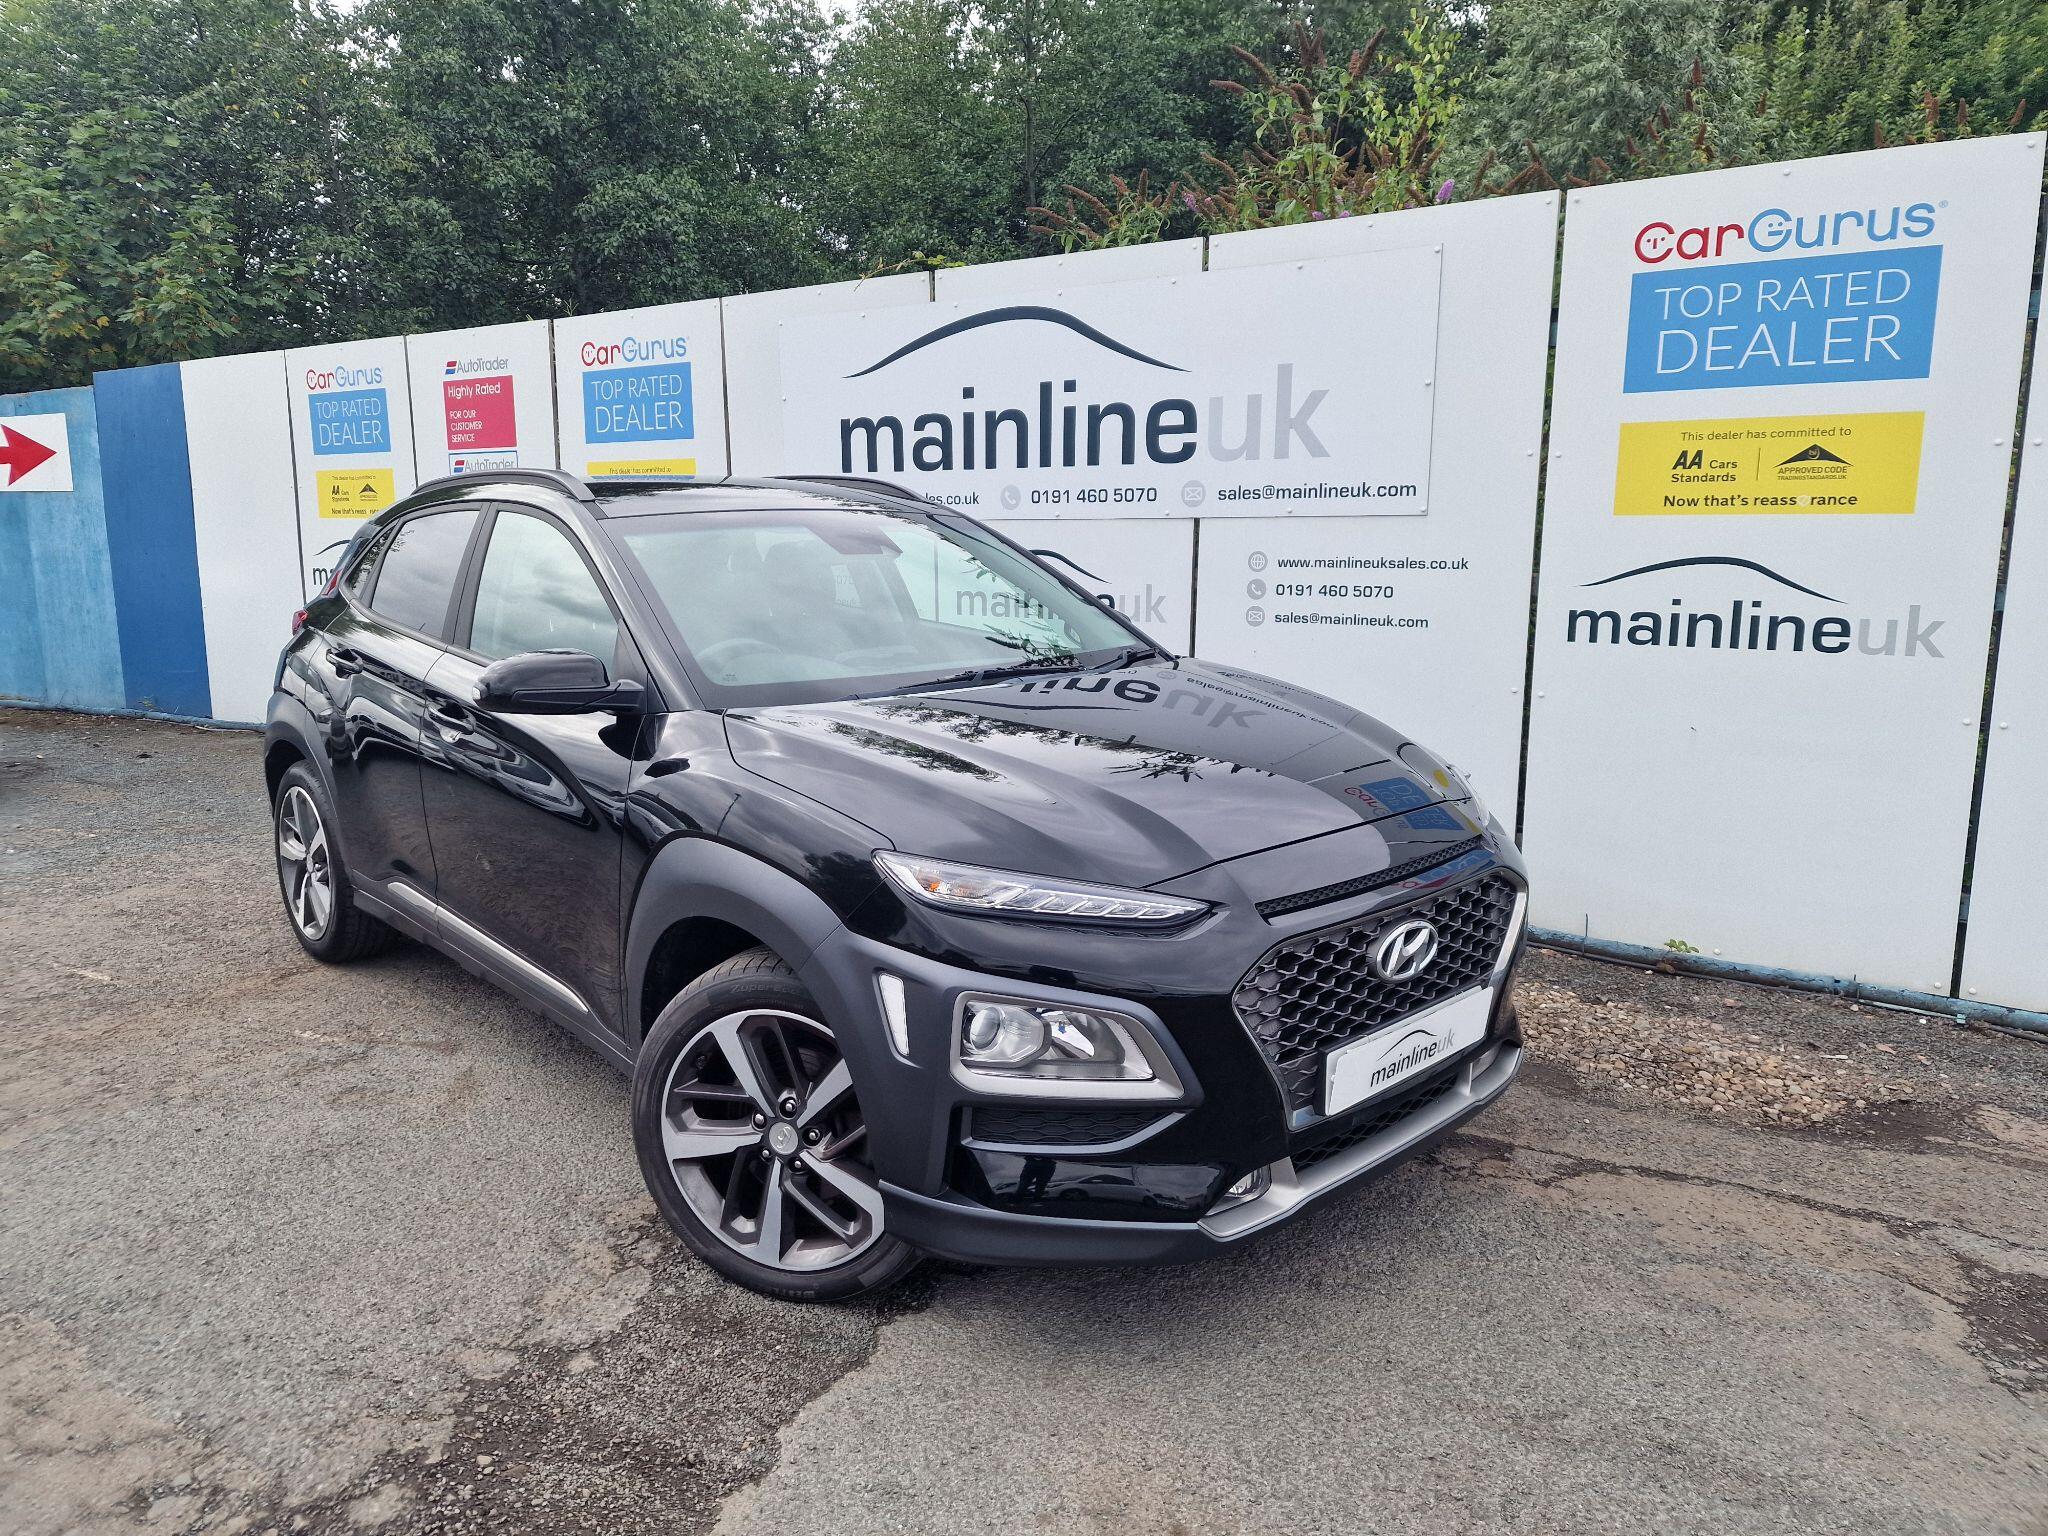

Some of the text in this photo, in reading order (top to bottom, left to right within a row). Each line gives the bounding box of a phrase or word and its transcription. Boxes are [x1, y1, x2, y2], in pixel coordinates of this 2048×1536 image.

[1634, 202, 1937, 264] CarGurus
[1655, 268, 1911, 320] TOP RATED
[581, 337, 687, 366] CarGurus
[1655, 314, 1902, 374] DEALER
[457, 356, 509, 374] AutoTrader
[306, 366, 382, 390] CarGurus
[591, 374, 683, 400] TOP RATED
[448, 382, 501, 399] Highly Rated
[315, 398, 381, 419] TOP RATED
[450, 410, 477, 419] FOR OUR
[595, 401, 684, 433] DEALER
[451, 421, 483, 431] CUSTOMER
[841, 363, 1331, 474] mainlineuk
[319, 420, 383, 446] DEALER
[451, 433, 475, 443] SERVICE
[1681, 427, 1852, 441] This dealer has committed to
[1672, 450, 1738, 470] AA Cars
[1778, 465, 1848, 474] APPROVED CODE
[1671, 472, 1736, 483] Standards
[1031, 487, 1158, 504] 0191 460 5070
[1218, 482, 1417, 501] sales@mainlineuk.com
[1663, 494, 1858, 507] Now that's reassrance
[1277, 557, 1469, 570] www.mainlineuksales.co.uk
[1276, 584, 1394, 598] 0191 460 5070
[1275, 612, 1429, 628] sales@mainlineuk.com
[1566, 598, 1945, 659] mainlineuk
[1369, 1028, 1455, 1088] mainlineuk
